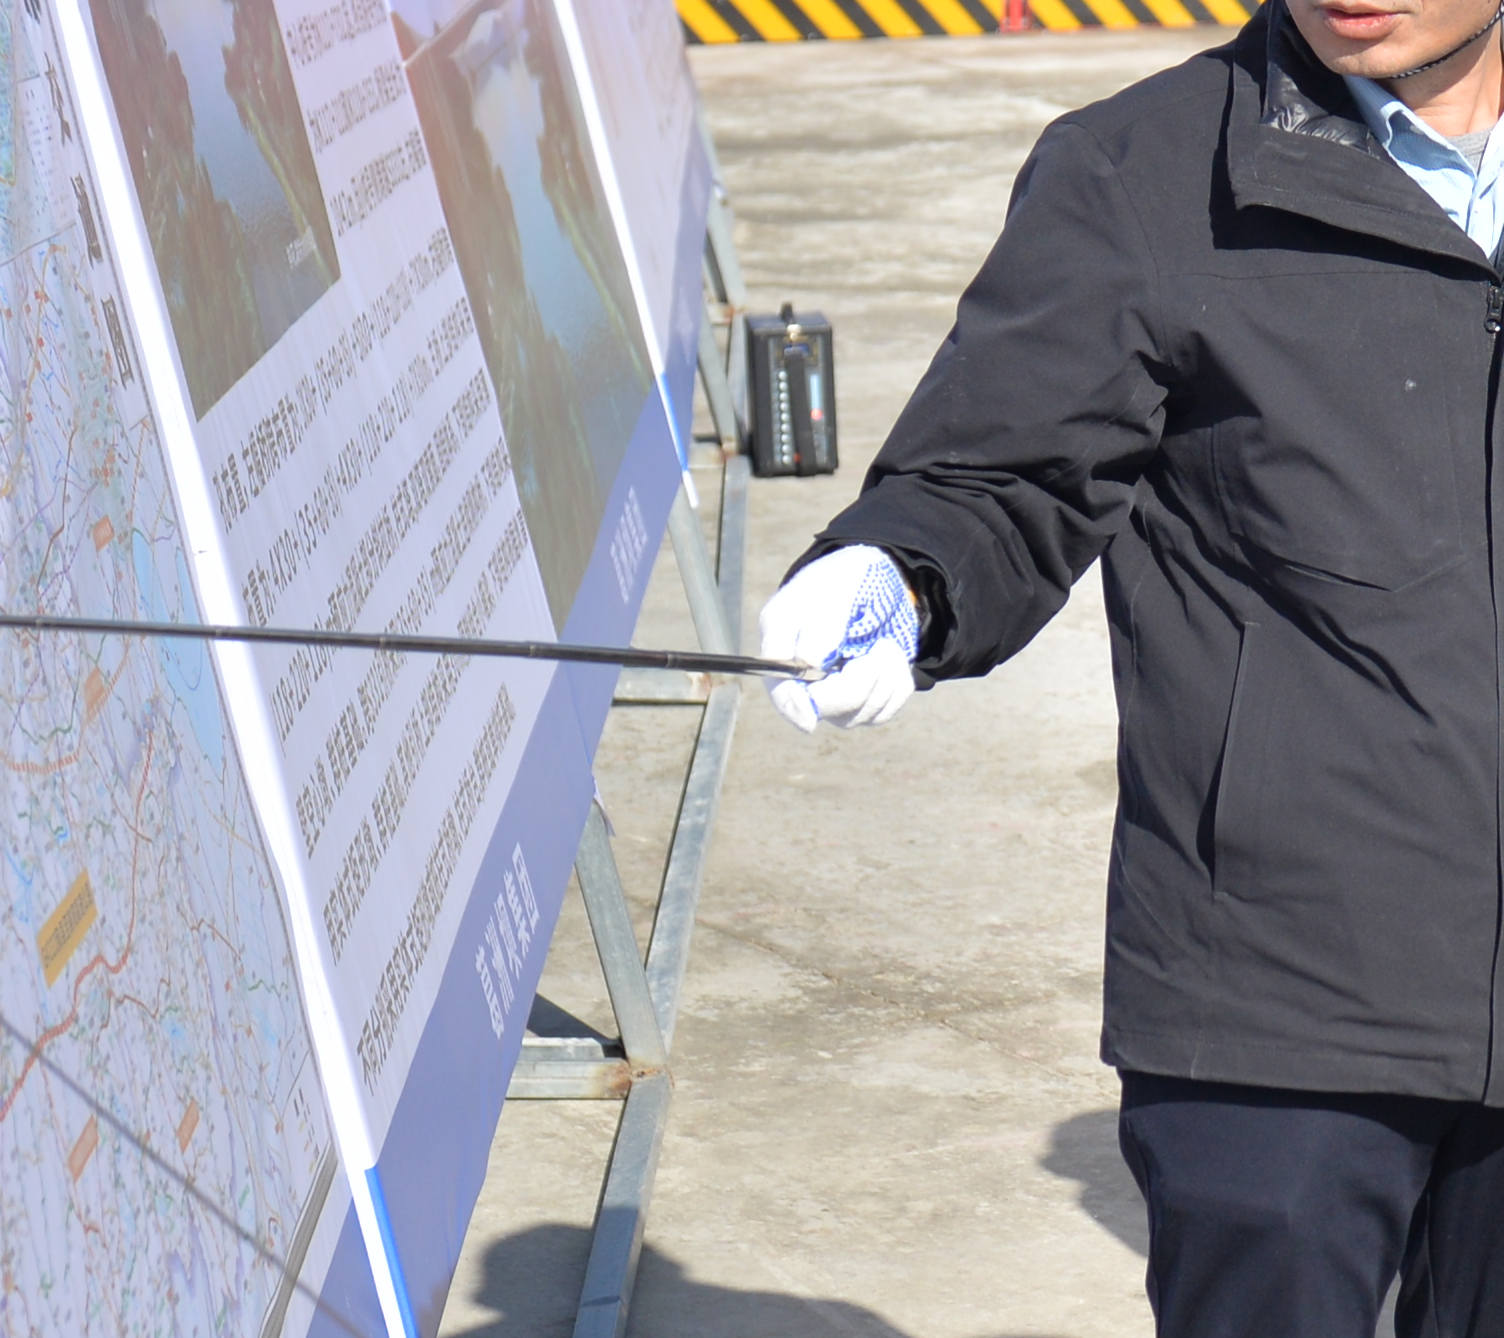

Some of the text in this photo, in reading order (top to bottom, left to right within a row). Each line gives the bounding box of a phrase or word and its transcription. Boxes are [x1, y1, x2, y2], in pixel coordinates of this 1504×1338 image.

[475, 841, 541, 1041] 葛洲坝集团
